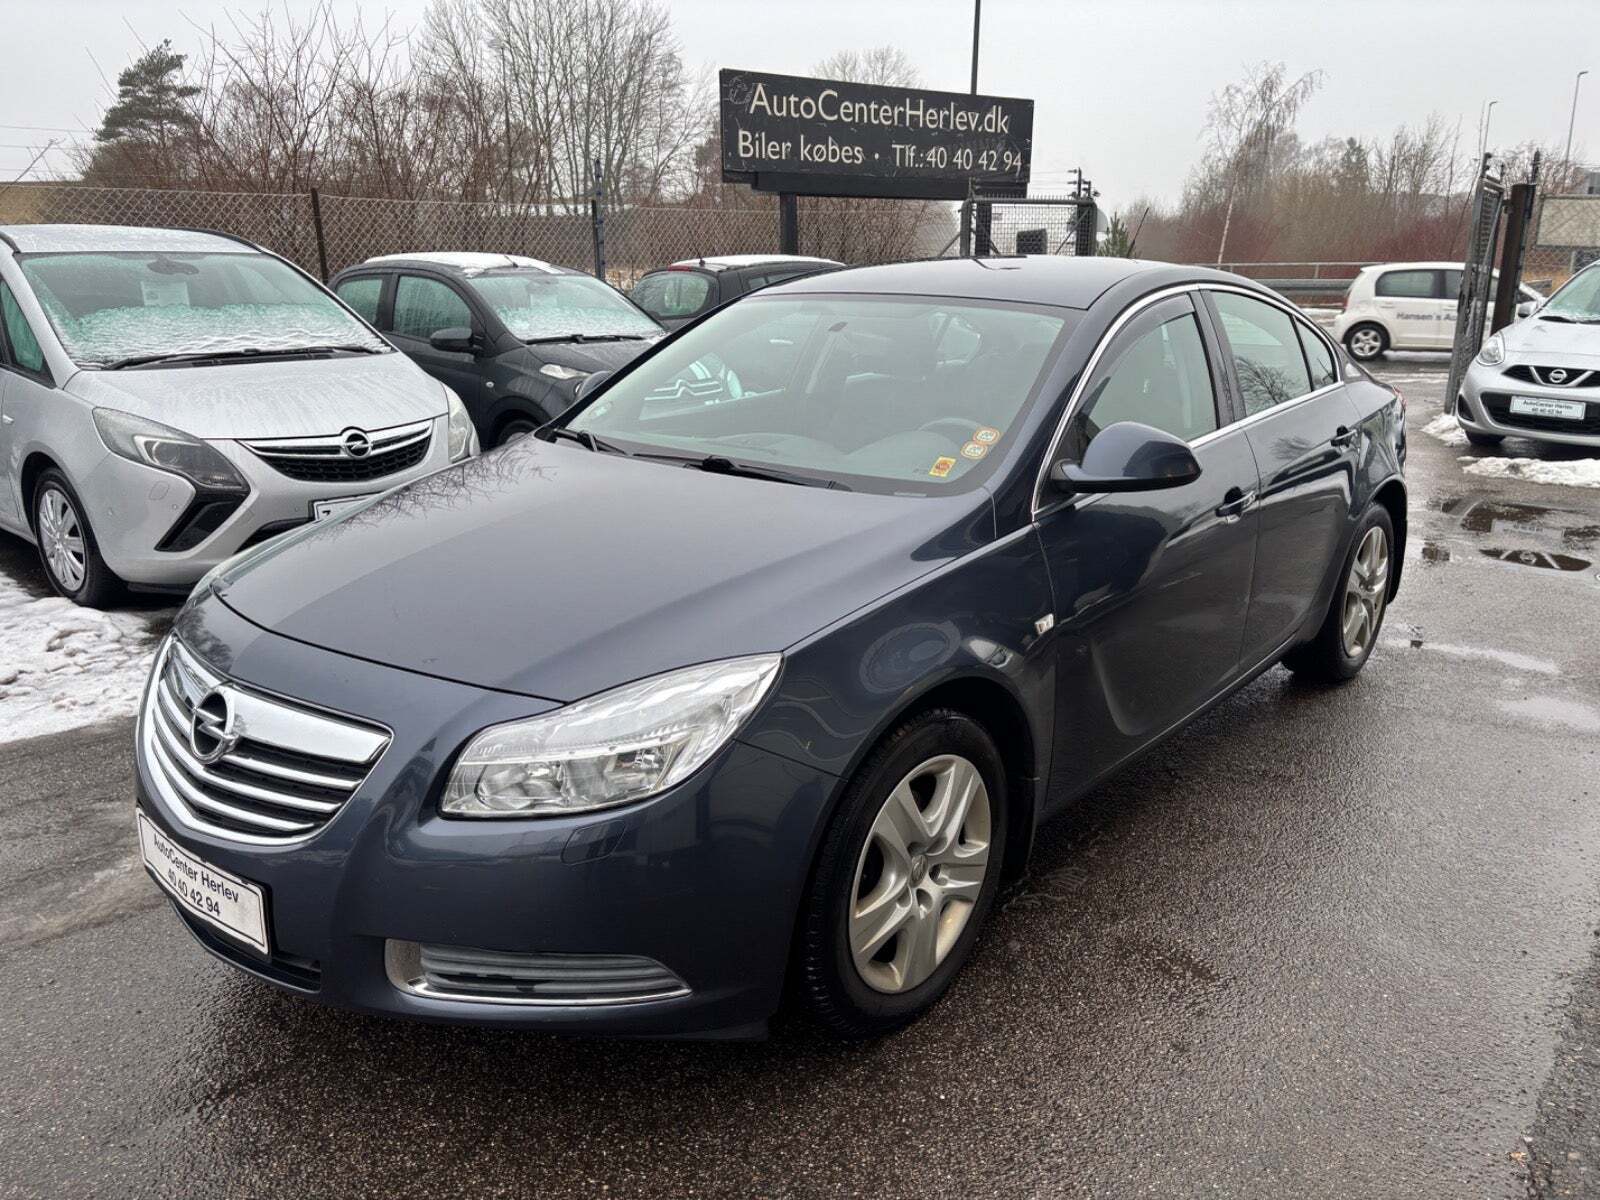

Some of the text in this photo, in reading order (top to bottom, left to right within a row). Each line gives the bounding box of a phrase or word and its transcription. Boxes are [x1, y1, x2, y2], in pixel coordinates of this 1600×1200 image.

[750, 83, 1009, 134] AutoCenterHerlev.dk
[738, 129, 792, 160] Biler
[800, 134, 863, 164] købes
[952, 151, 973, 170] 40
[978, 151, 997, 171] 42
[1003, 151, 1022, 176] 94
[153, 833, 239, 903] AutoCenter Herlev
[167, 868, 221, 916] 40 40 42 94
